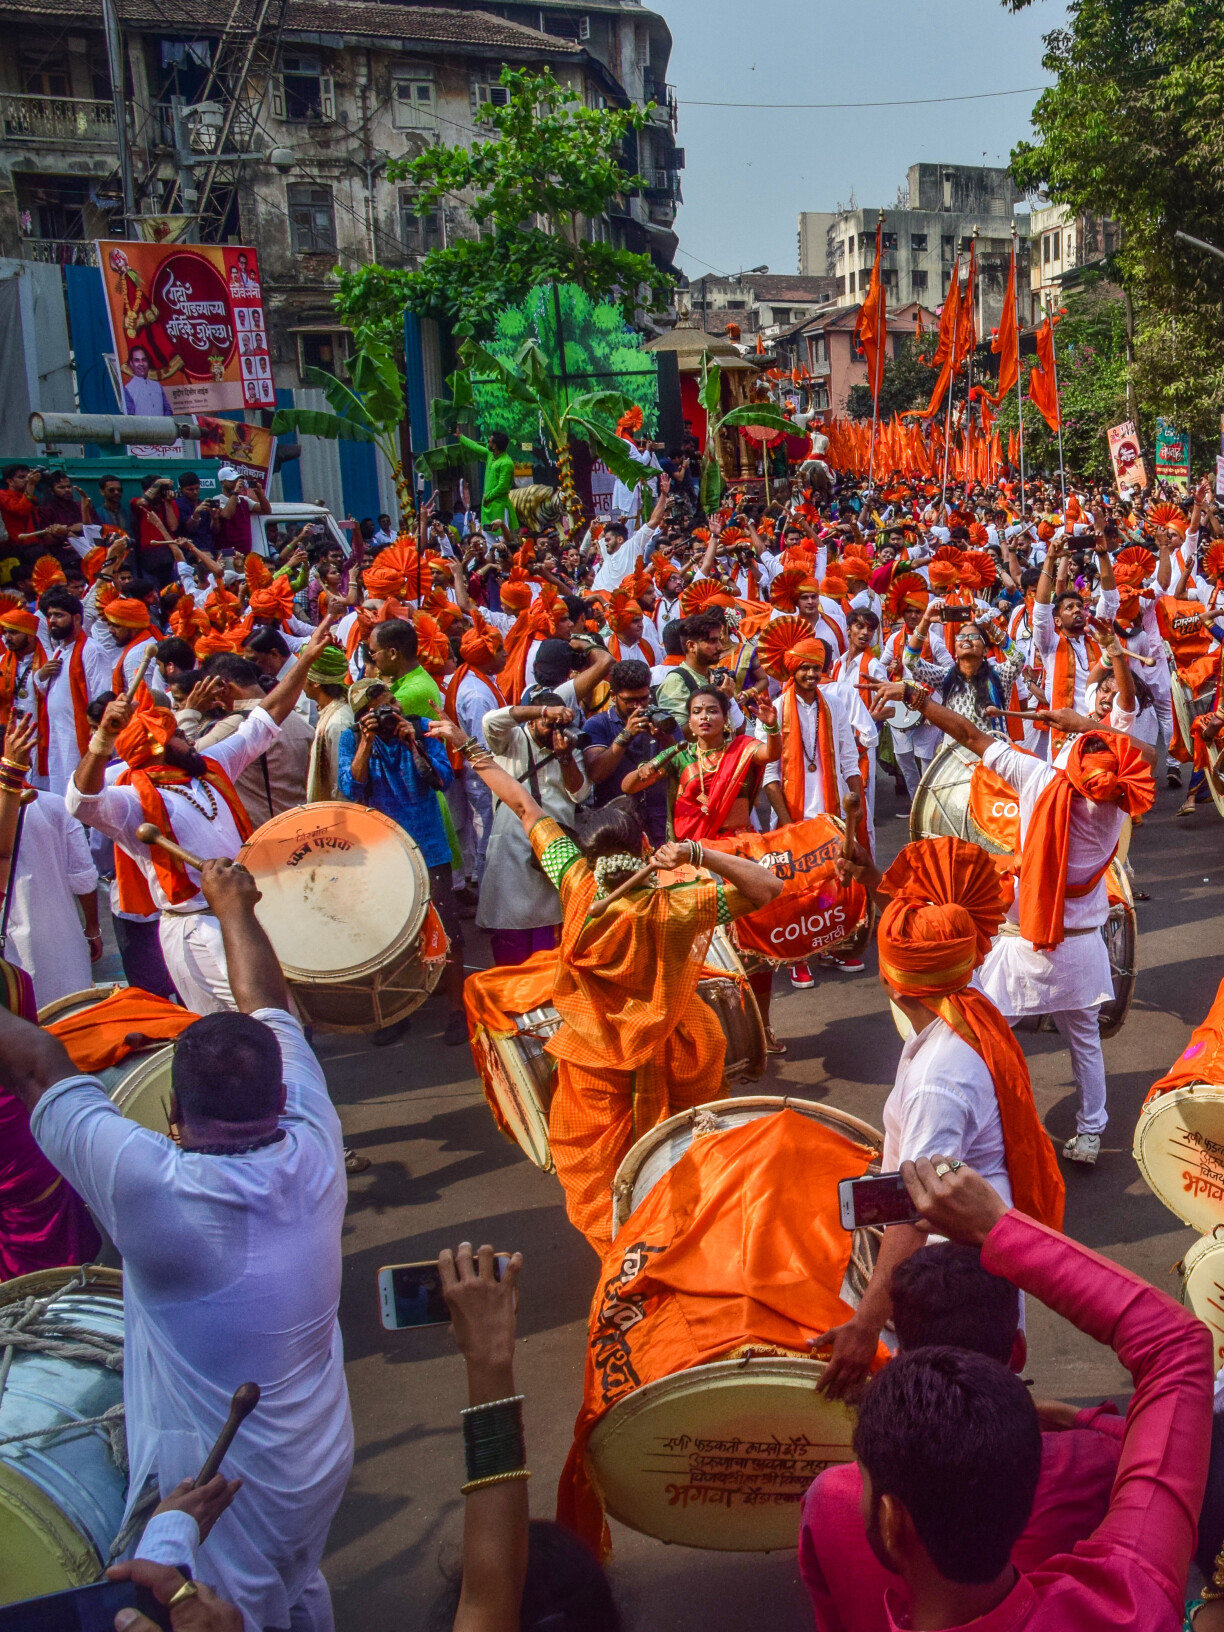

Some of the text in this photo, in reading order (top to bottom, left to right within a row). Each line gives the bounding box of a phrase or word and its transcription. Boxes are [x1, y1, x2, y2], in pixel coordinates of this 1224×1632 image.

[313, 837, 355, 851] पथक
[770, 905, 846, 943] colors
[811, 925, 845, 948] मराठी
[1182, 1131, 1203, 1147] रणी
[662, 1434, 692, 1452] रणी
[694, 1437, 744, 1452] फडकती
[664, 1482, 743, 1509] भगवा
